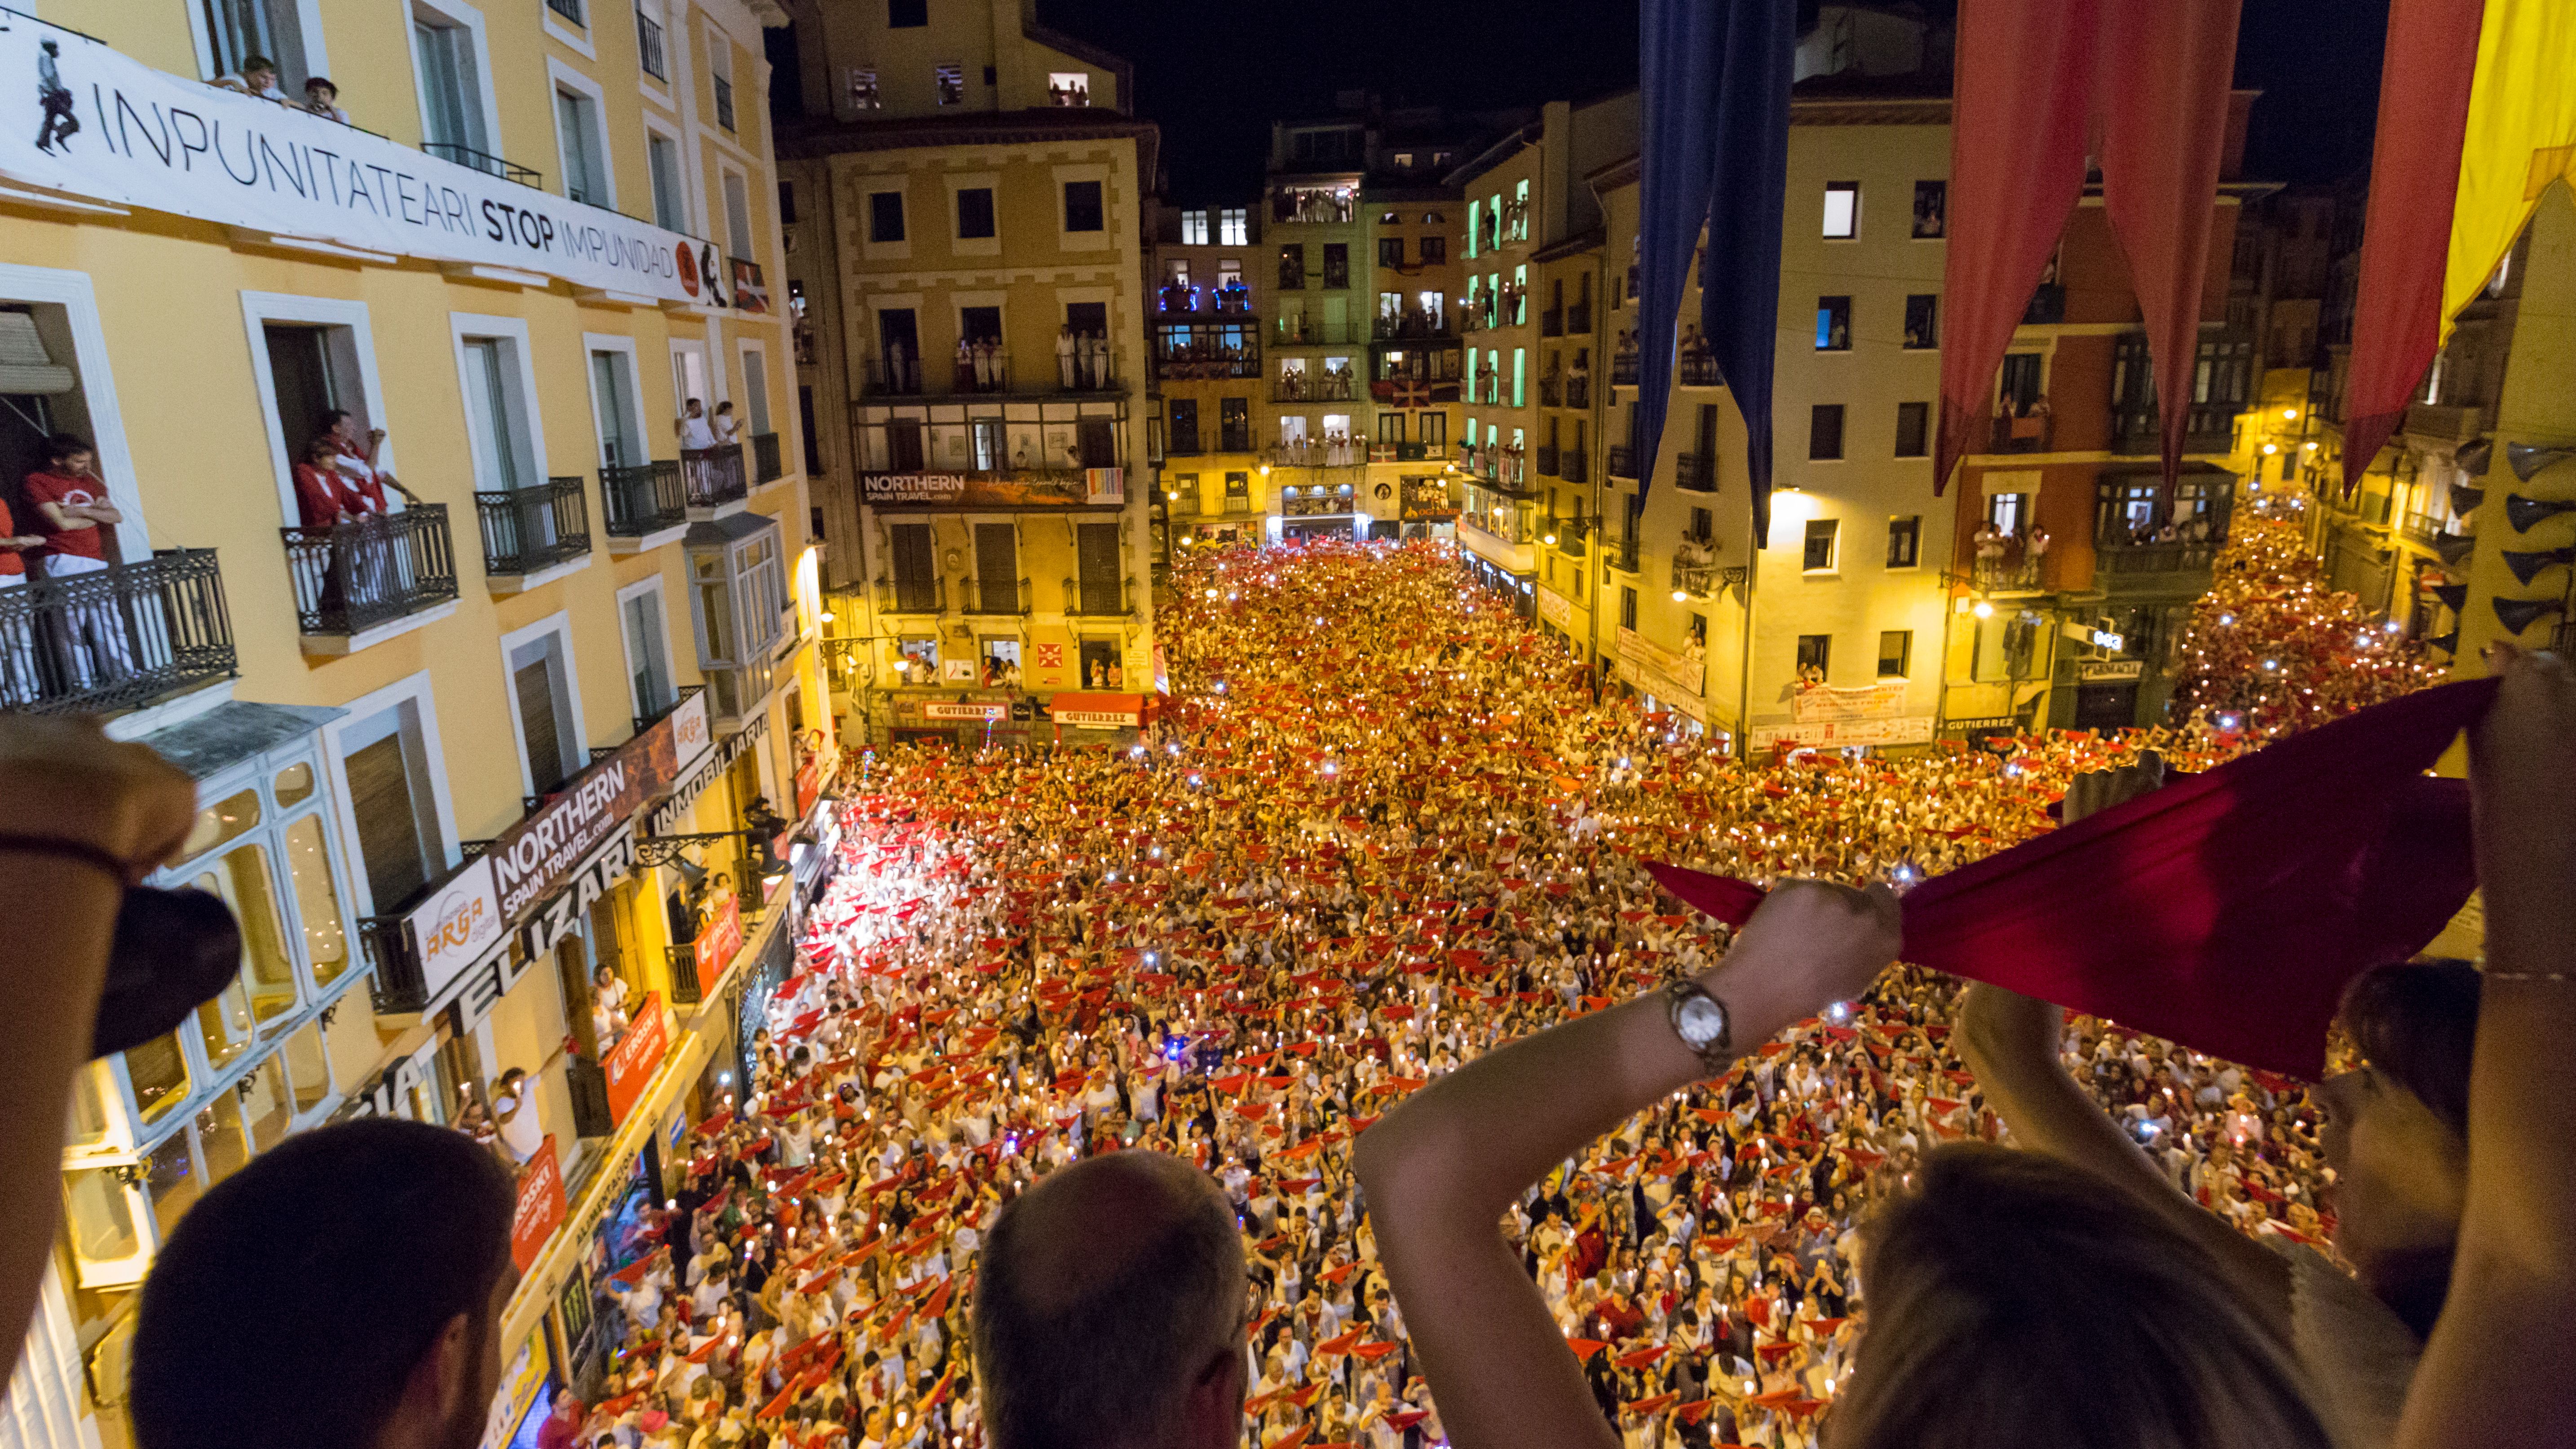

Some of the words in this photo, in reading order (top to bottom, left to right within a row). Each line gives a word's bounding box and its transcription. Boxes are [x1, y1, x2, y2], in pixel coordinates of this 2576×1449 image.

[93, 84, 476, 237] INPUNITATEARI
[482, 199, 554, 252] STOP
[559, 220, 674, 278] IMPUNIDAD
[865, 476, 964, 491] NORTHERN
[866, 492, 893, 501] SPAIN
[1066, 712, 1126, 722] GUTIERREZ
[1948, 718, 2014, 730] GUTIERREZ
[654, 712, 769, 836] INMOBILIARIA
[495, 760, 625, 895] NORTHERN
[503, 869, 545, 919] SPAIN
[544, 812, 614, 879] TRAVEL.com
[427, 897, 483, 963] ARGA
[459, 832, 635, 1034] ELIZARI
[625, 1010, 656, 1061] EROSKI
[515, 1164, 550, 1226] ROSKI
